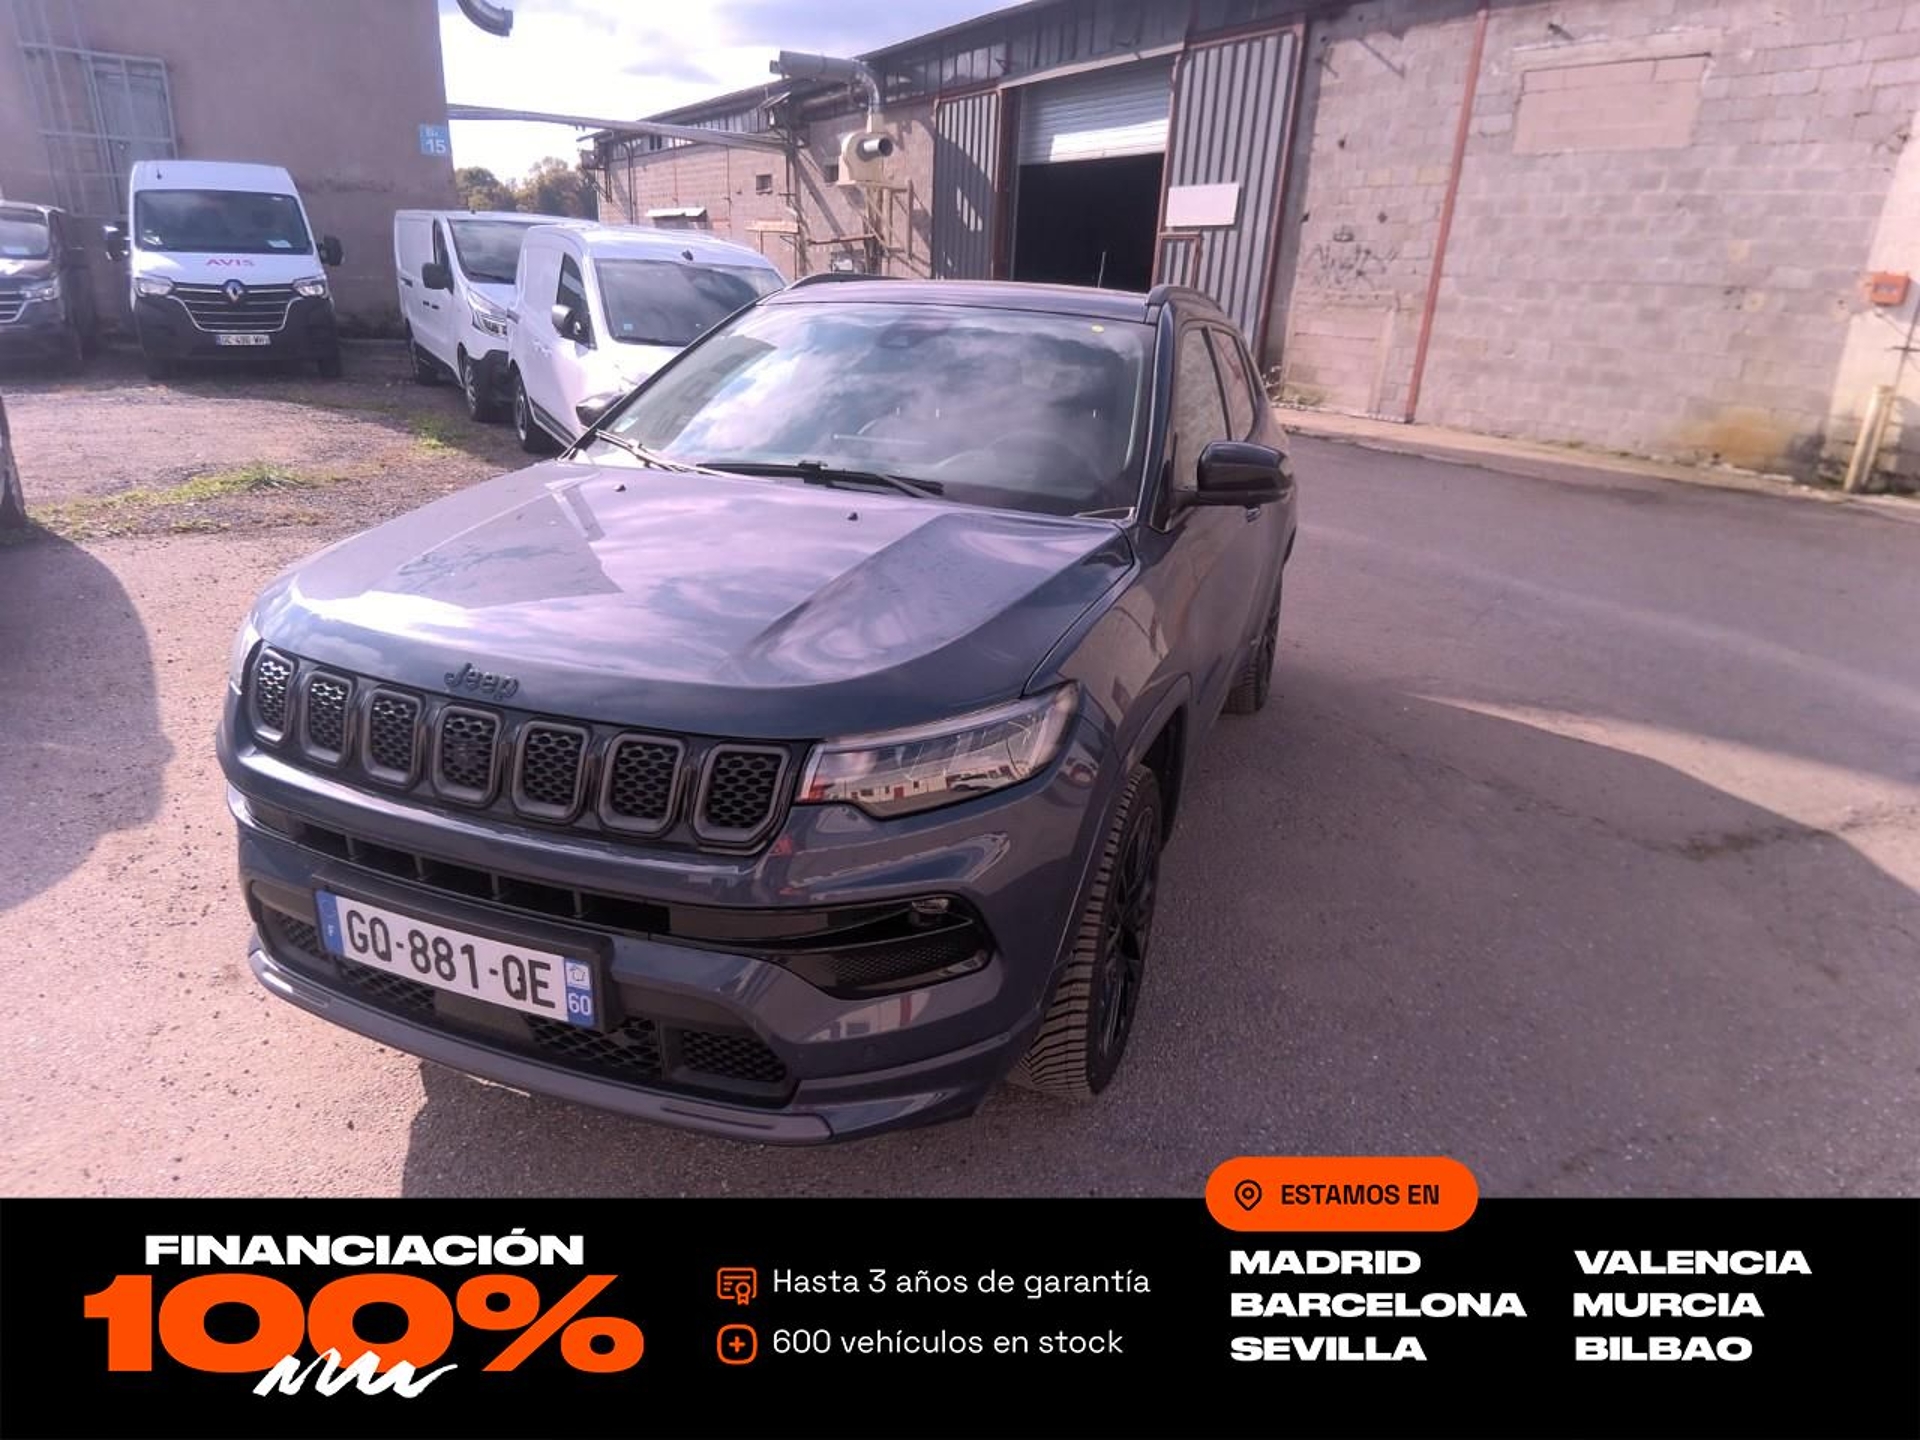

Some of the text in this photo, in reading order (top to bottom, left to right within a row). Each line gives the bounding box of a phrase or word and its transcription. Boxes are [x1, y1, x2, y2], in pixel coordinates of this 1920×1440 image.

[425, 139, 447, 154] 15
[206, 258, 256, 267] AVIS
[443, 662, 519, 701] Jeep
[346, 909, 556, 1009] GQ-881-QE
[567, 992, 592, 1016] 60
